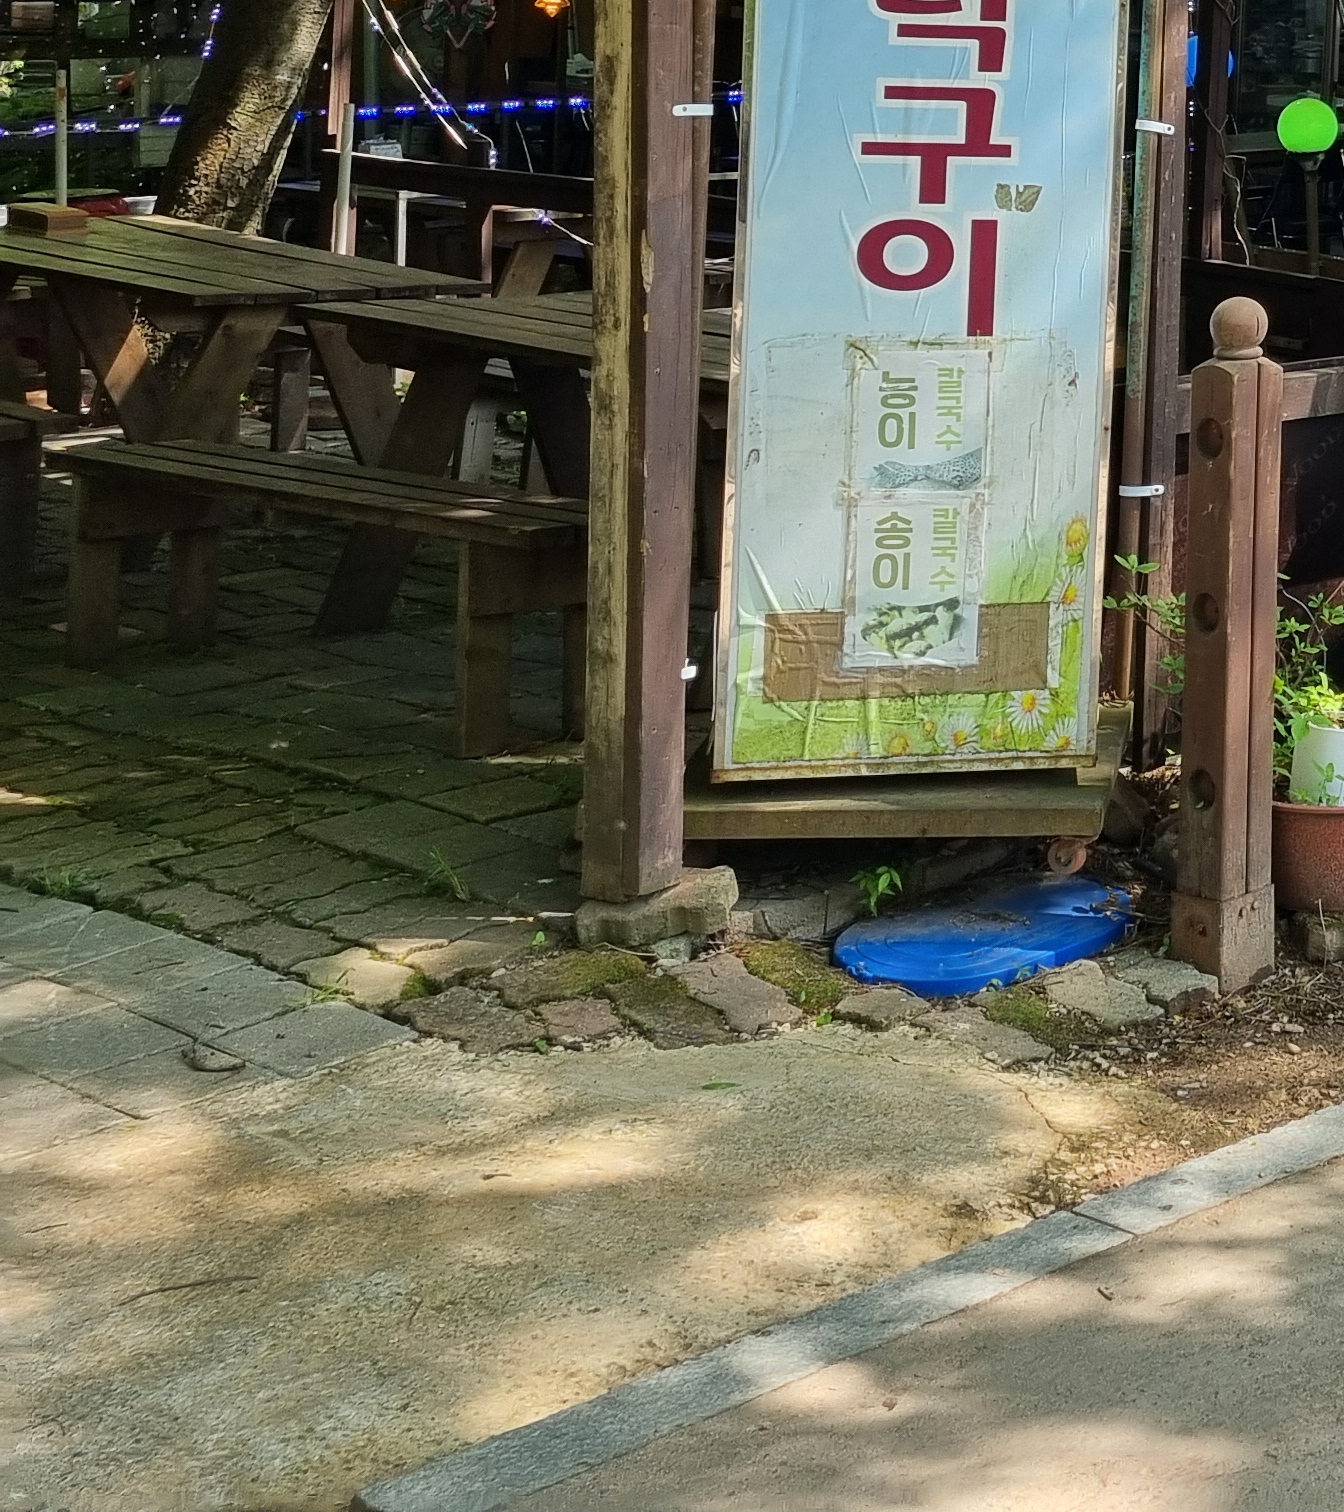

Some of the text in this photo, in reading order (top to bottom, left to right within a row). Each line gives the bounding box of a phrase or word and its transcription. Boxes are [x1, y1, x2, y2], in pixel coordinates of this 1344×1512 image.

[877, 366, 965, 451] 능이 칼국수
[872, 507, 960, 593] 송이 칼국수
